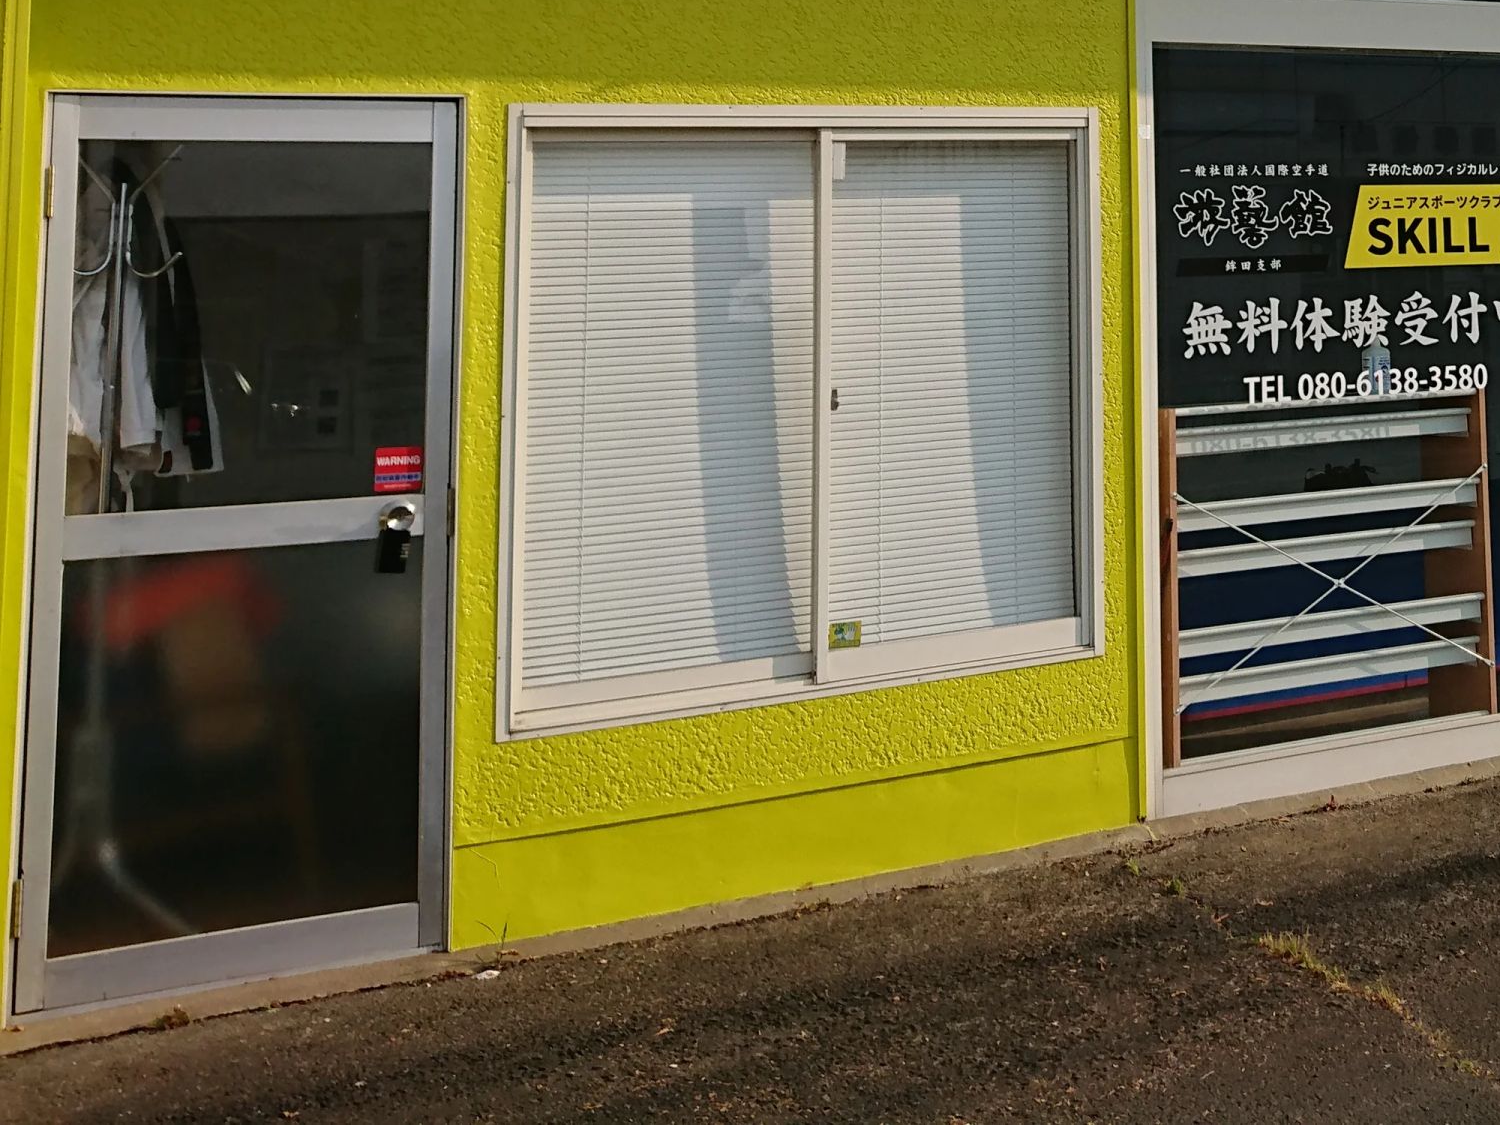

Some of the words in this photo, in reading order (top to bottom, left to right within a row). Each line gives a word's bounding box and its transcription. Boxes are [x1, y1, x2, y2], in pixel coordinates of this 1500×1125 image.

[1179, 163, 1330, 177] 一般社団法人国際空手道
[1367, 216, 1490, 256] SKILL
[1225, 259, 1282, 271] 鉾田支部
[1243, 374, 1292, 405] TEL
[1298, 364, 1489, 401] 080-6138-3580
[376, 455, 421, 467] WARNING
